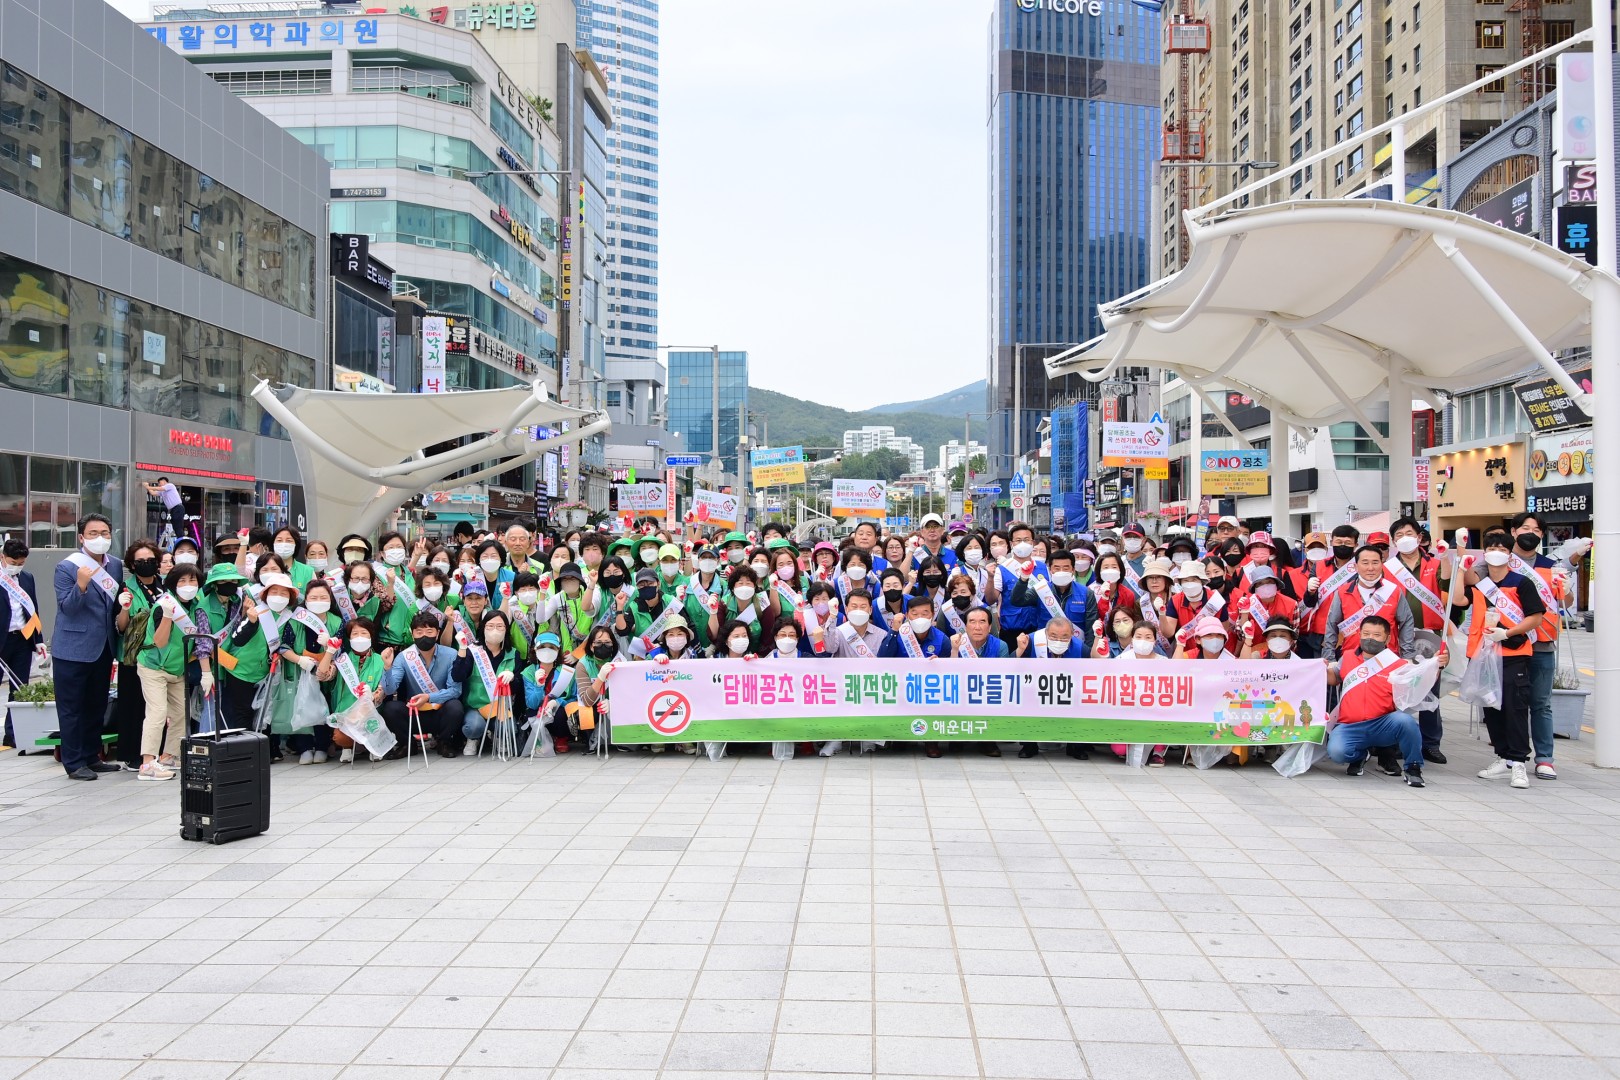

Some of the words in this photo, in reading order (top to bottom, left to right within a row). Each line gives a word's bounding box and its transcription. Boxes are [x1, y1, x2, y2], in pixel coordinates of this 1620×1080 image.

[467, 4, 537, 31] 뮤직타운
[1515, 212, 1525, 228] 3F
[1565, 222, 1590, 249] 휴
[348, 237, 359, 271] BAR
[426, 337, 441, 365] 낙지
[169, 429, 202, 448] PHOTO
[1108, 429, 1136, 437] 담배꽁초는
[1242, 456, 1263, 468] 꽁초
[803, 674, 837, 705] 없는
[844, 672, 898, 705] 쾌적한
[905, 672, 959, 704] 해운대
[1037, 673, 1074, 706] 위한
[1081, 673, 1193, 707] 도시환경정비
[932, 720, 988, 735] 해운대구
